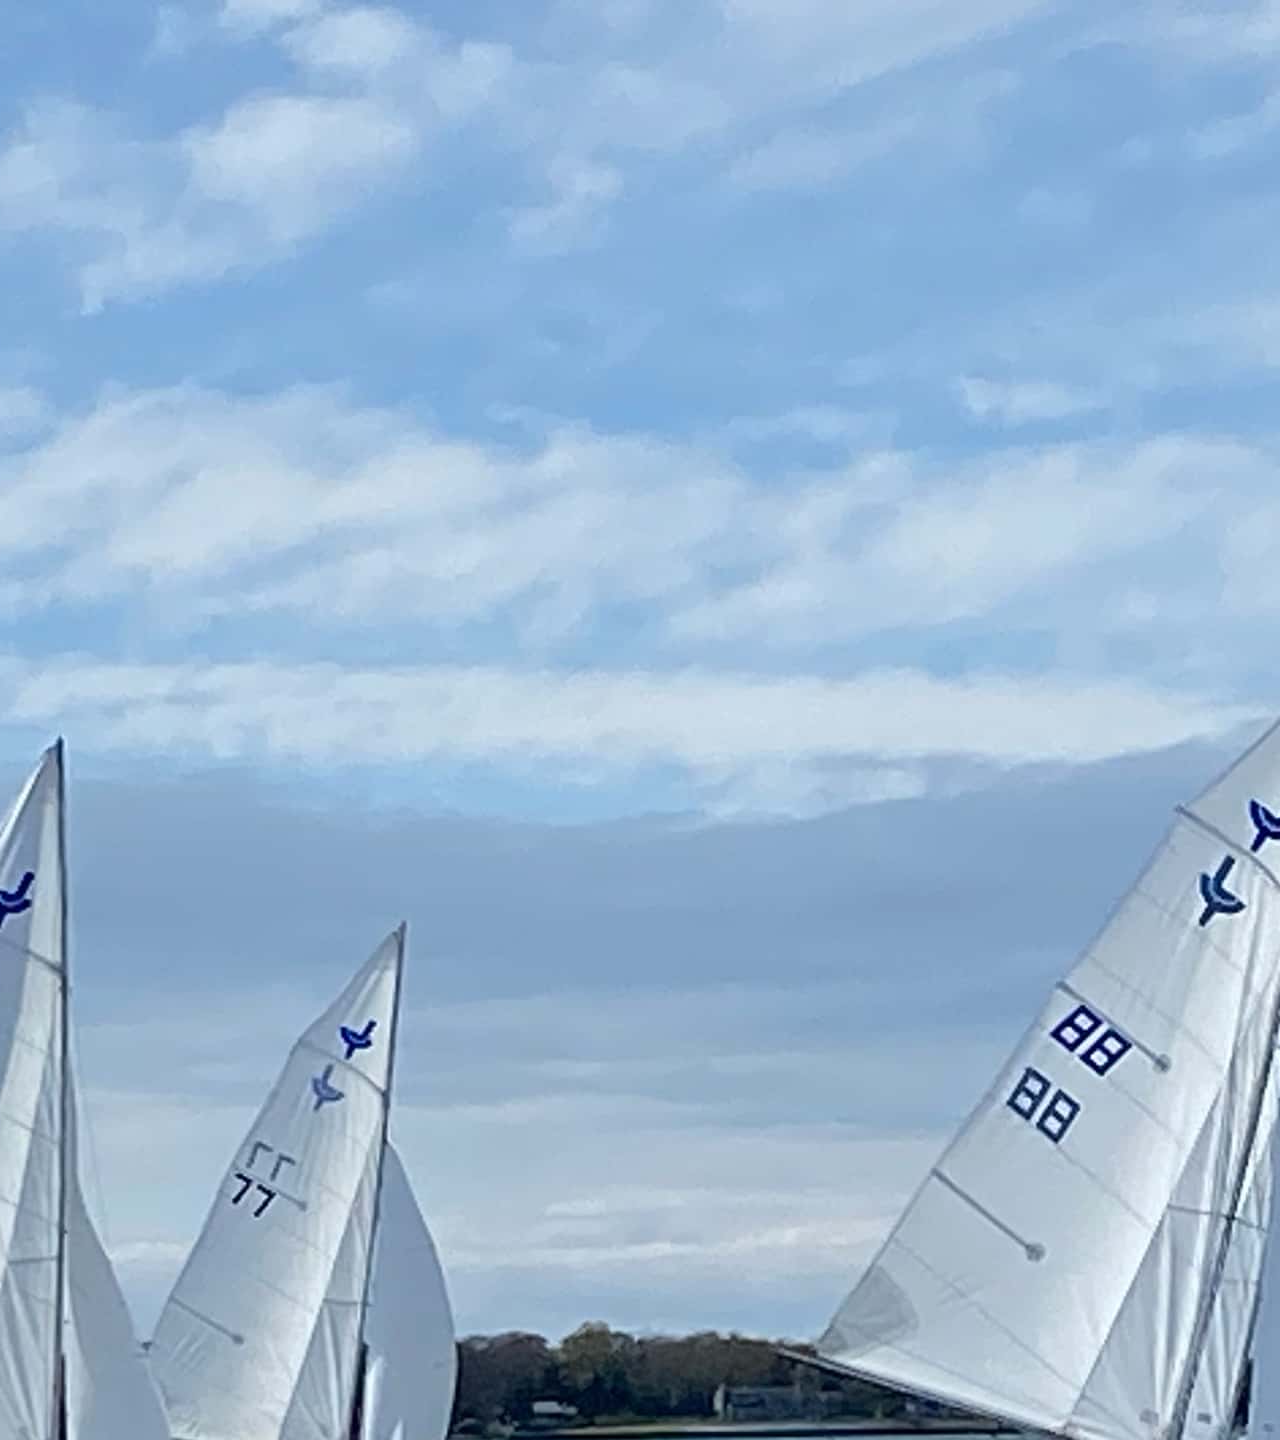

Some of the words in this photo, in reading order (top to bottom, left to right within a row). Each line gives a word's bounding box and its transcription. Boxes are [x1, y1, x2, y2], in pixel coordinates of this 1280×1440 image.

[1050, 1004, 1133, 1076] 88
[1006, 1066, 1081, 1144] 88
[231, 1173, 276, 1218] 77
